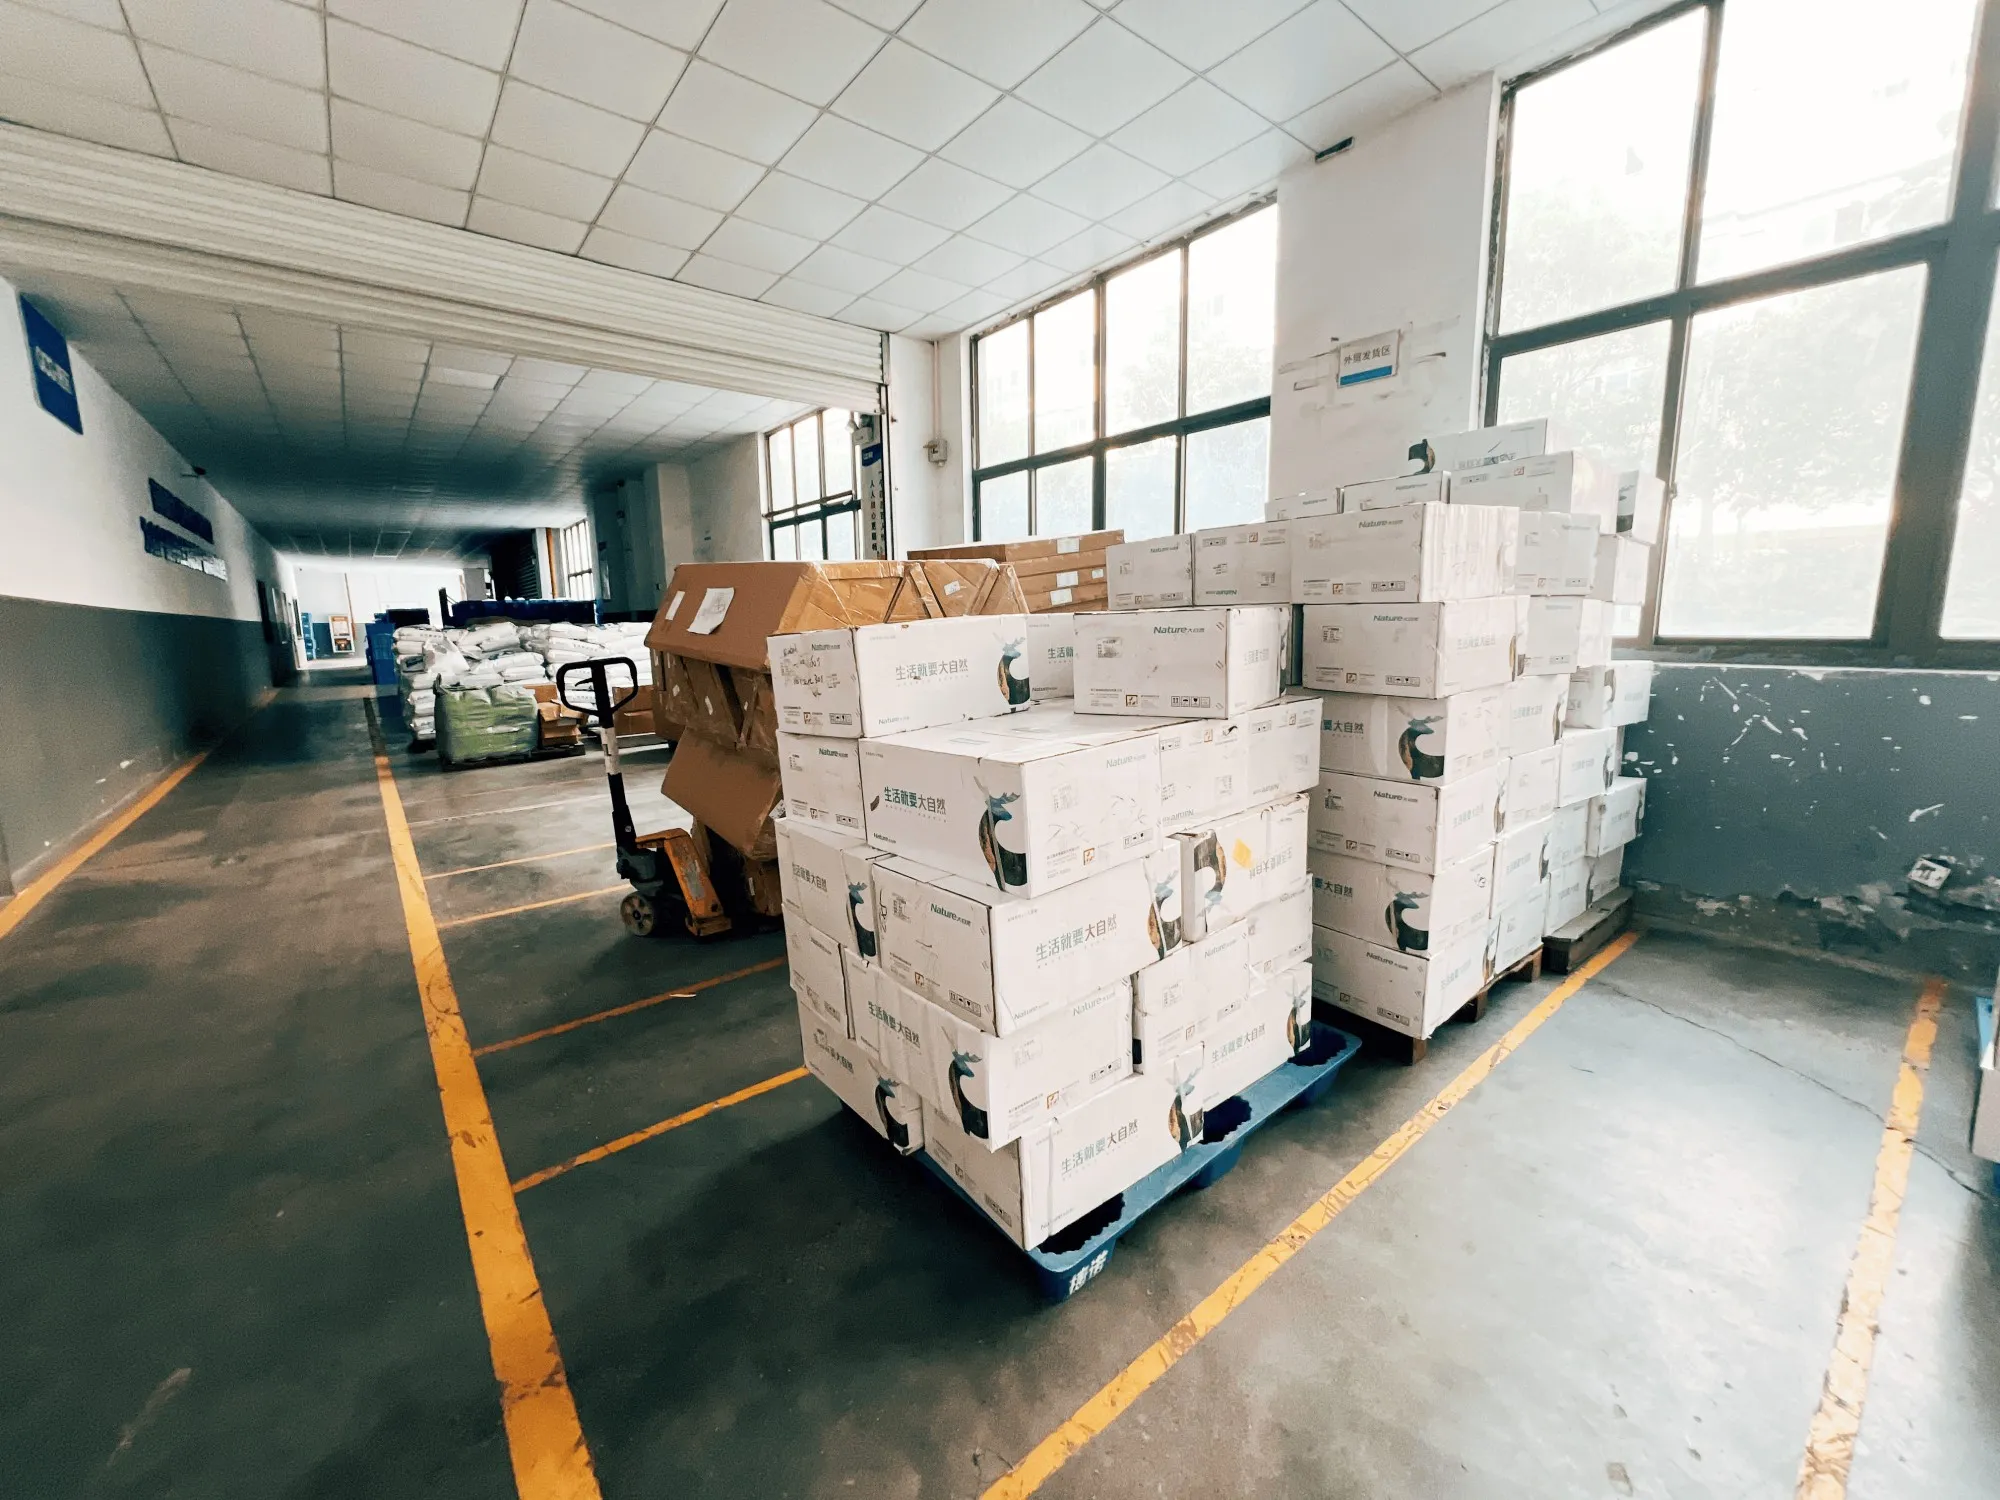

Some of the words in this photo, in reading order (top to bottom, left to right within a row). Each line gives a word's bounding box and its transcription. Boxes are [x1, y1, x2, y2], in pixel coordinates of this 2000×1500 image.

[1153, 626, 1187, 634] Nature
[895, 658, 969, 681] 生活就要大自然
[818, 747, 838, 757] Nature
[1106, 754, 1133, 769] Nature
[884, 786, 947, 815] 生活就要大自然
[1373, 790, 1403, 800] Nature
[930, 903, 957, 921] Nature
[1035, 914, 1117, 962] 生活就要大自然
[1366, 951, 1394, 966] Nature
[1073, 996, 1101, 1016] Nature
[868, 1000, 920, 1048] 生活就要大自然
[1061, 1118, 1139, 1175] 生活就要大自然
